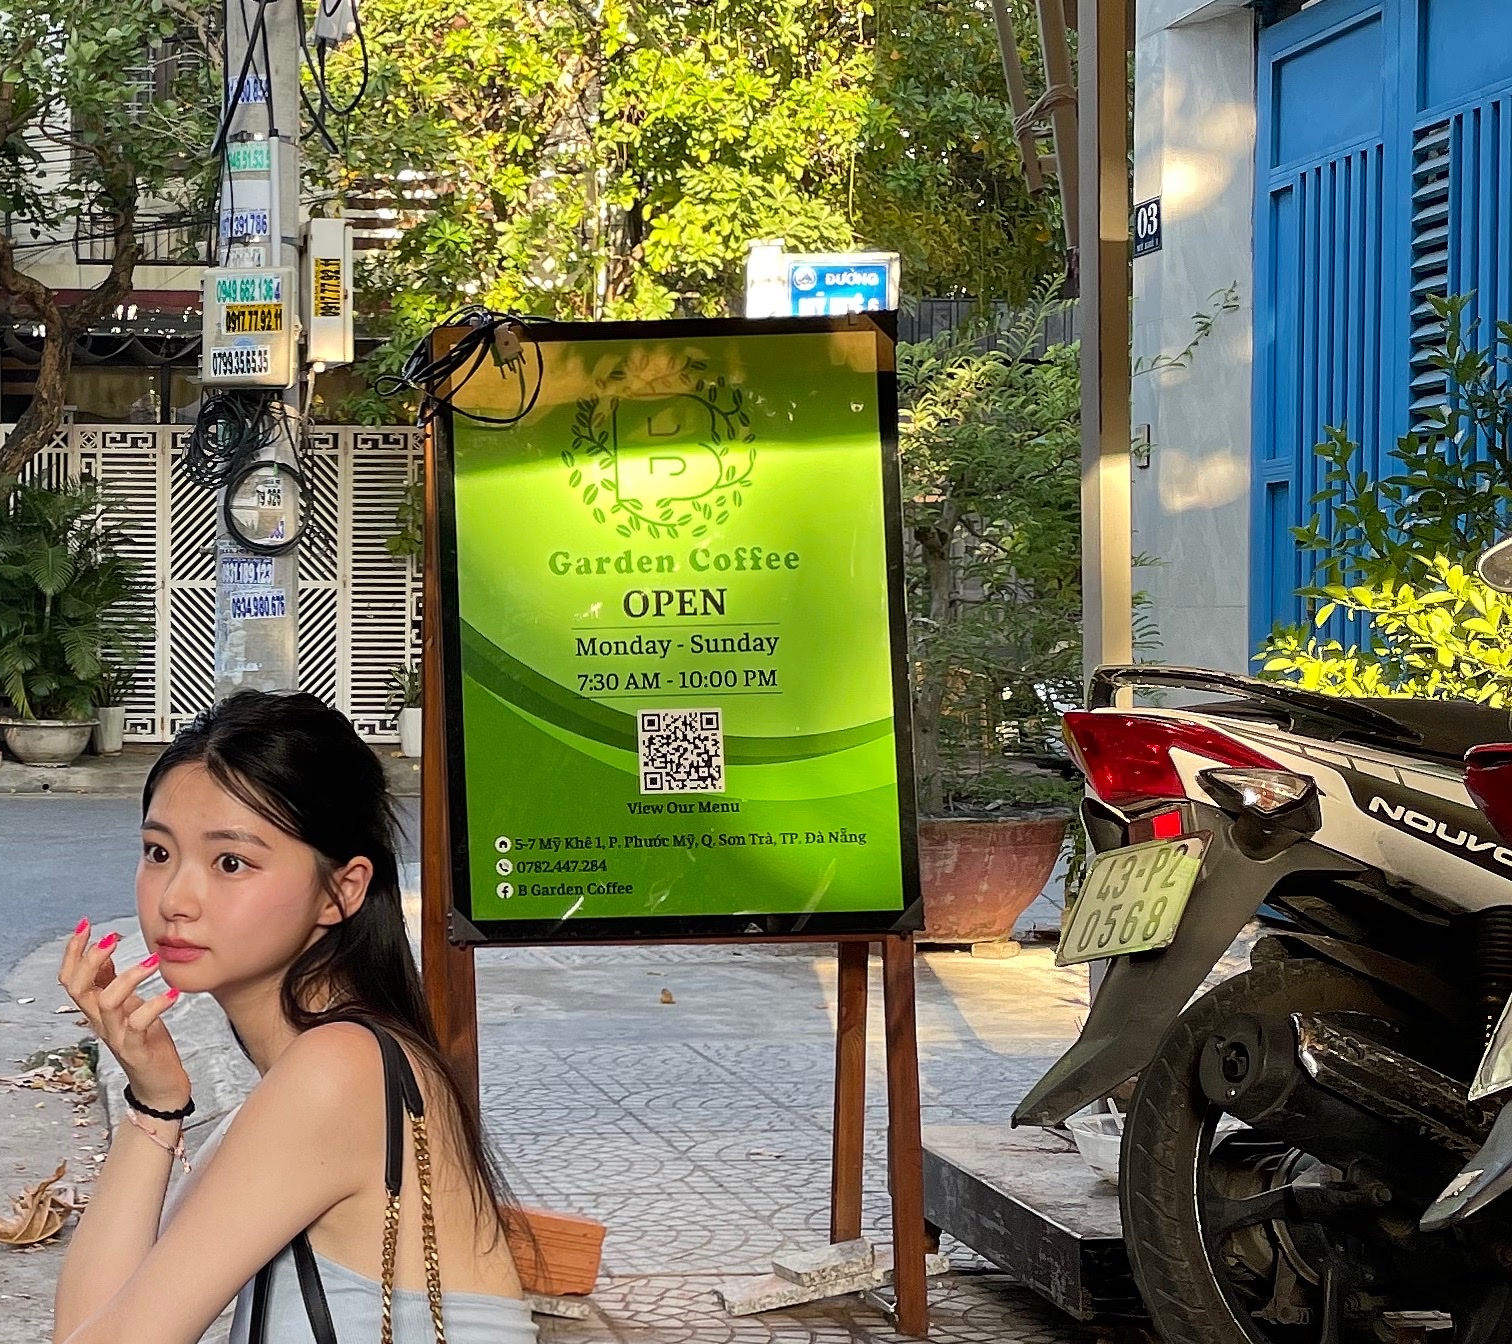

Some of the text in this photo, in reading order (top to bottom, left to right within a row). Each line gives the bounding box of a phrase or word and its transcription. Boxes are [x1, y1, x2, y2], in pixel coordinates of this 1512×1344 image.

[1137, 202, 1158, 239] 03
[548, 546, 801, 576] Garden Coffee
[623, 588, 727, 618] OPEN
[575, 635, 672, 659] Monday
[690, 632, 780, 656] Sunday
[577, 673, 619, 692] 7:30
[624, 672, 662, 690] AM
[679, 670, 737, 689] 10:00
[743, 669, 778, 687] PM
[626, 800, 740, 815] View Our Menu
[514, 838, 536, 851] 5-7
[539, 836, 562, 853] Mỹ
[564, 836, 593, 850] Khê
[608, 836, 622, 849] P.
[701, 833, 716, 849] Q.
[748, 831, 777, 847] Trà,
[779, 832, 802, 846] TP.
[804, 831, 824, 845] Đà
[516, 859, 608, 874] 0782.447.284
[517, 881, 634, 897] B Garden Coffee
[1076, 895, 1169, 953] 0568
